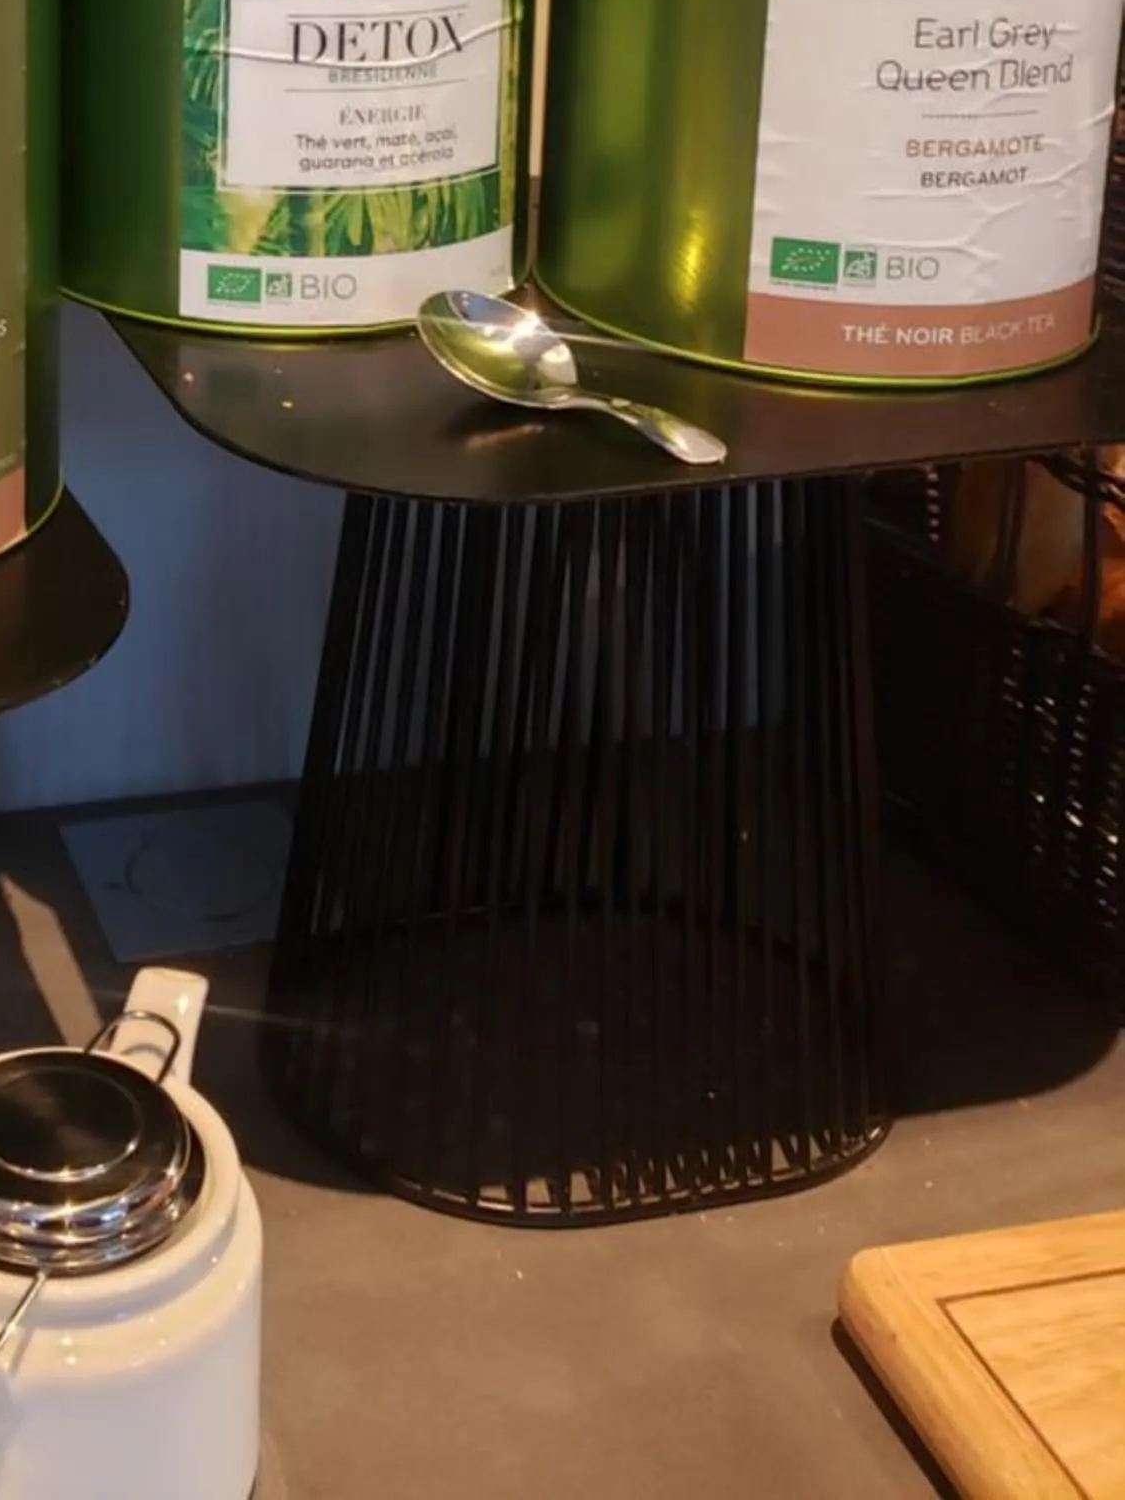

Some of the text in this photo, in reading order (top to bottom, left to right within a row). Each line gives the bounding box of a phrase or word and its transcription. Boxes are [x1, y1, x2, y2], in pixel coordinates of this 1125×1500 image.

[288, 13, 466, 64] DETOX
[914, 17, 1056, 51] Earl Grey
[876, 54, 1074, 91] Queen Blend
[906, 133, 1046, 158] BERGAMOTE
[920, 166, 1029, 189] BERGAMOT
[886, 255, 940, 281] BIO
[299, 272, 358, 301] BIO
[841, 321, 889, 345] THÉ
[895, 326, 954, 346] NOIR
[960, 319, 1023, 346] BLACK
